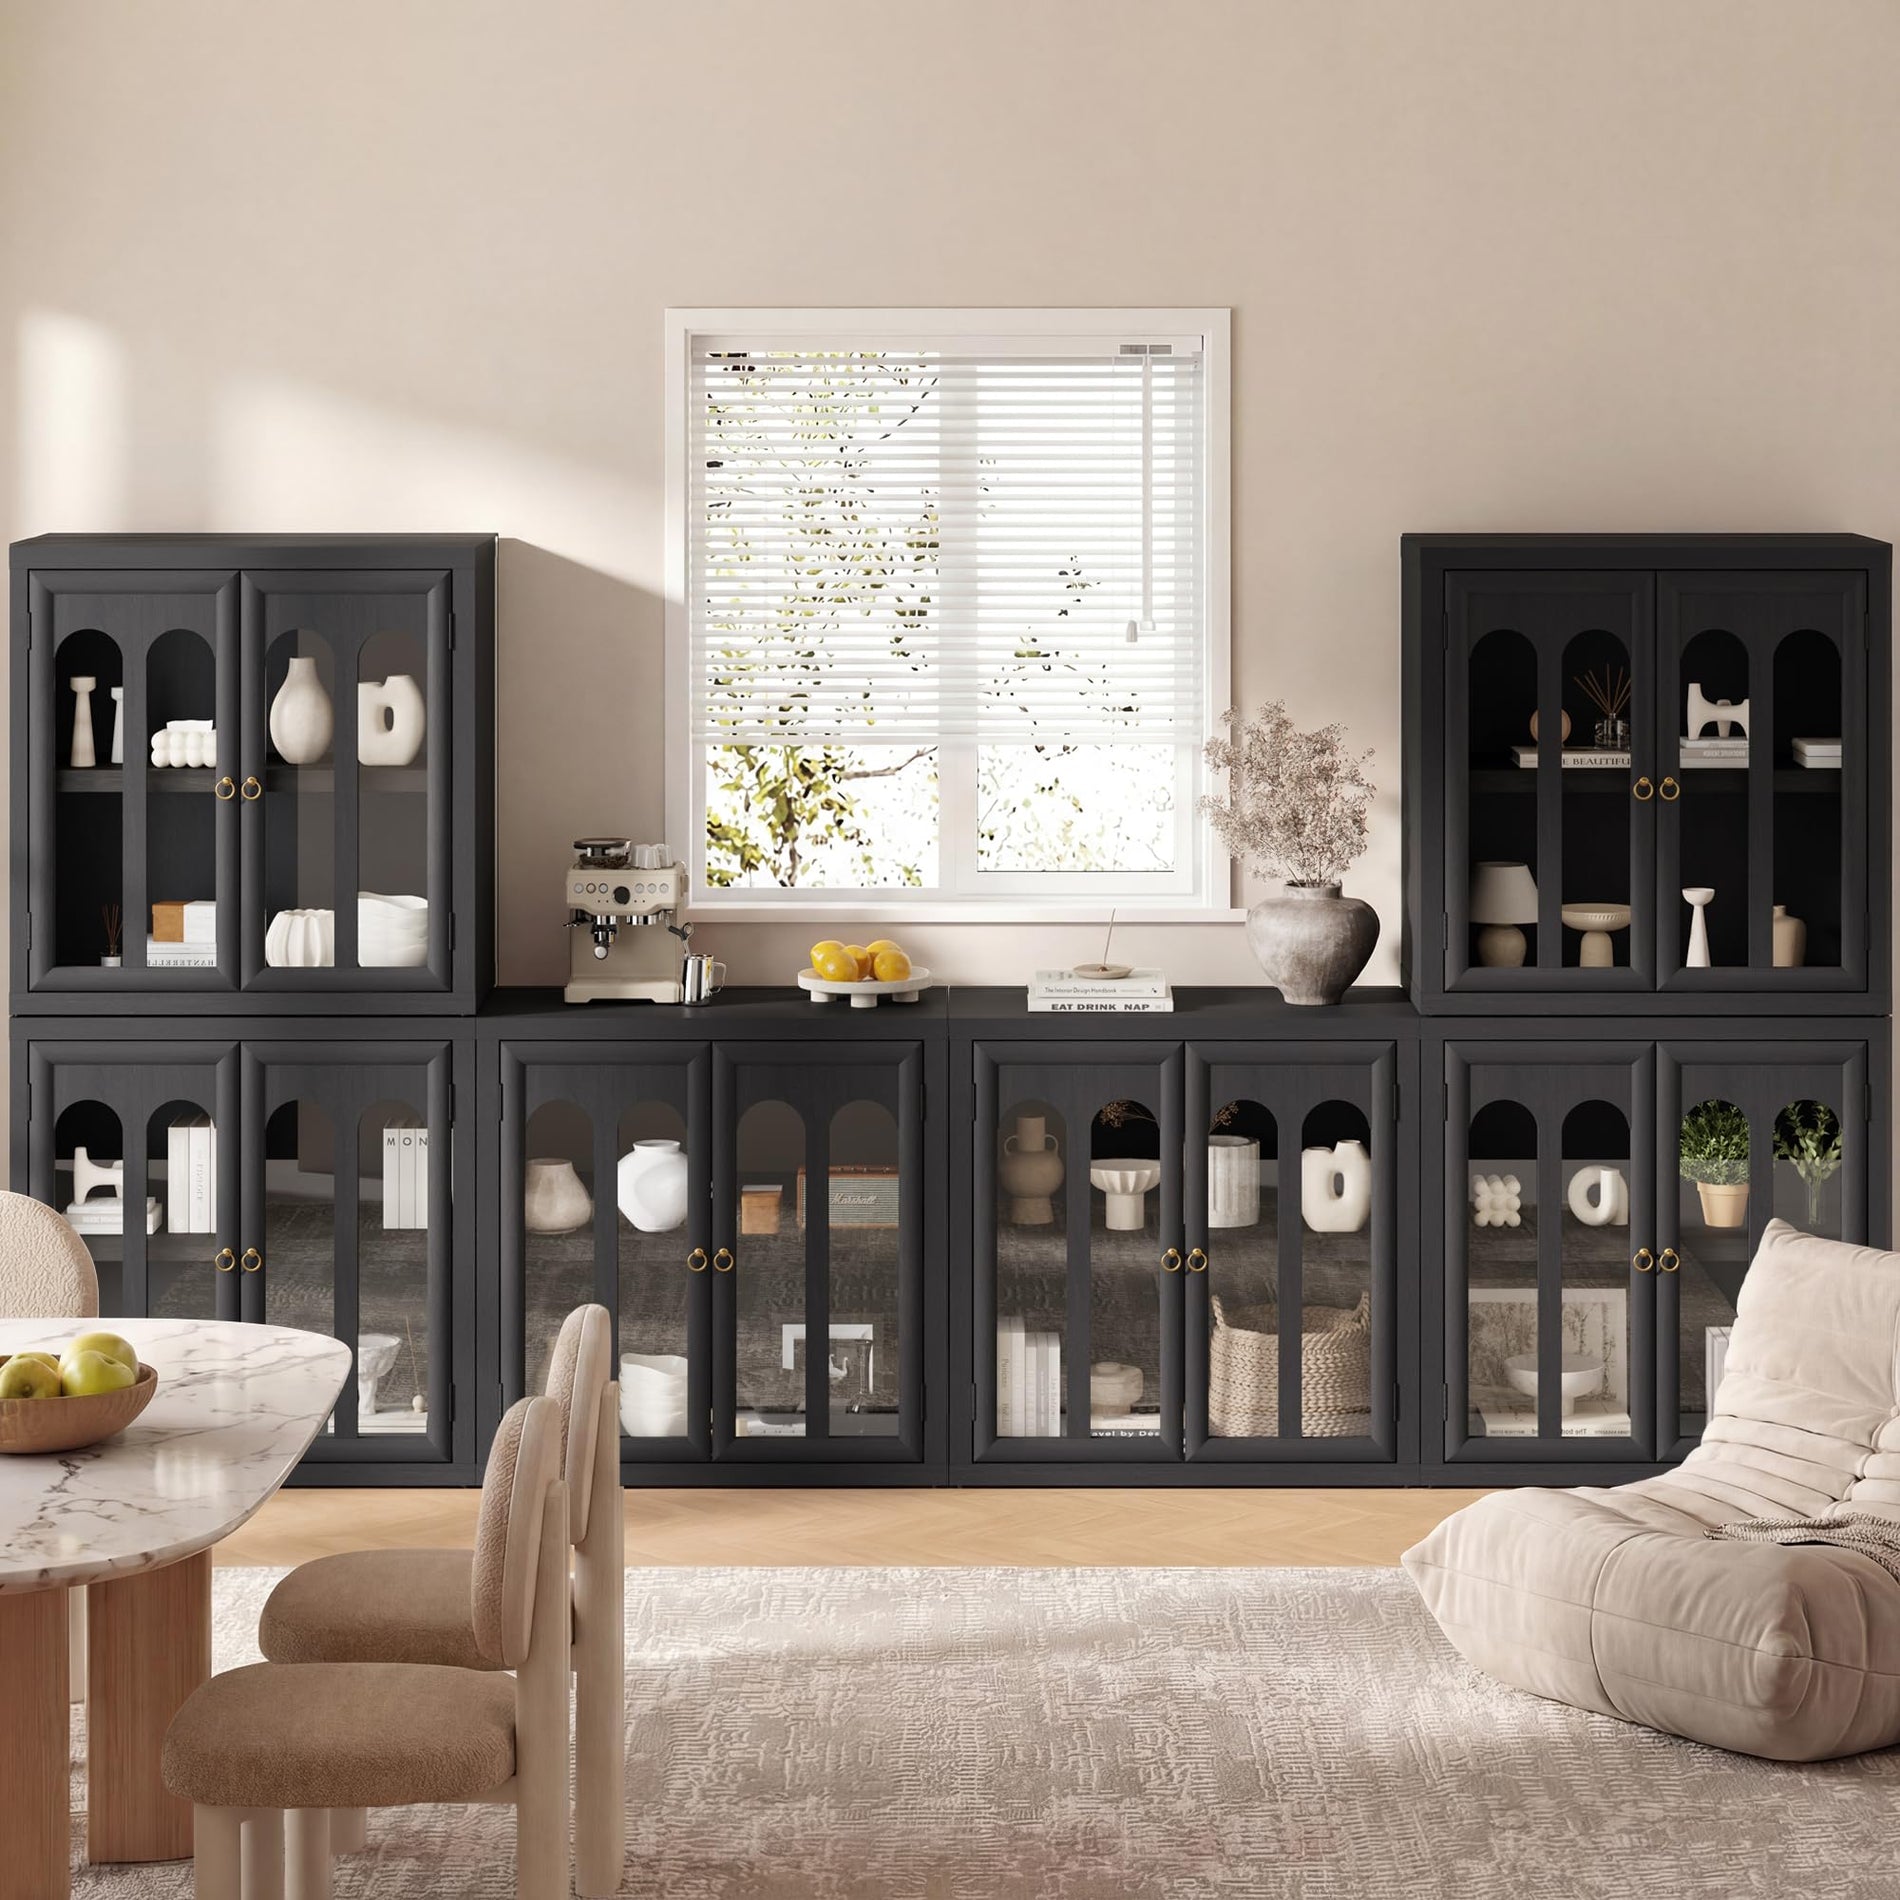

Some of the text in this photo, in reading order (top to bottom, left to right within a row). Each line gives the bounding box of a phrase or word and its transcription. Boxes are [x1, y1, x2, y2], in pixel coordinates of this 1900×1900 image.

[1051, 1003, 1073, 1011] EAT
[1077, 1003, 1116, 1011] DRINK
[1124, 1003, 1150, 1011] NAP
[830, 1193, 877, 1205] Marshall
[1120, 1430, 1134, 1438] by
